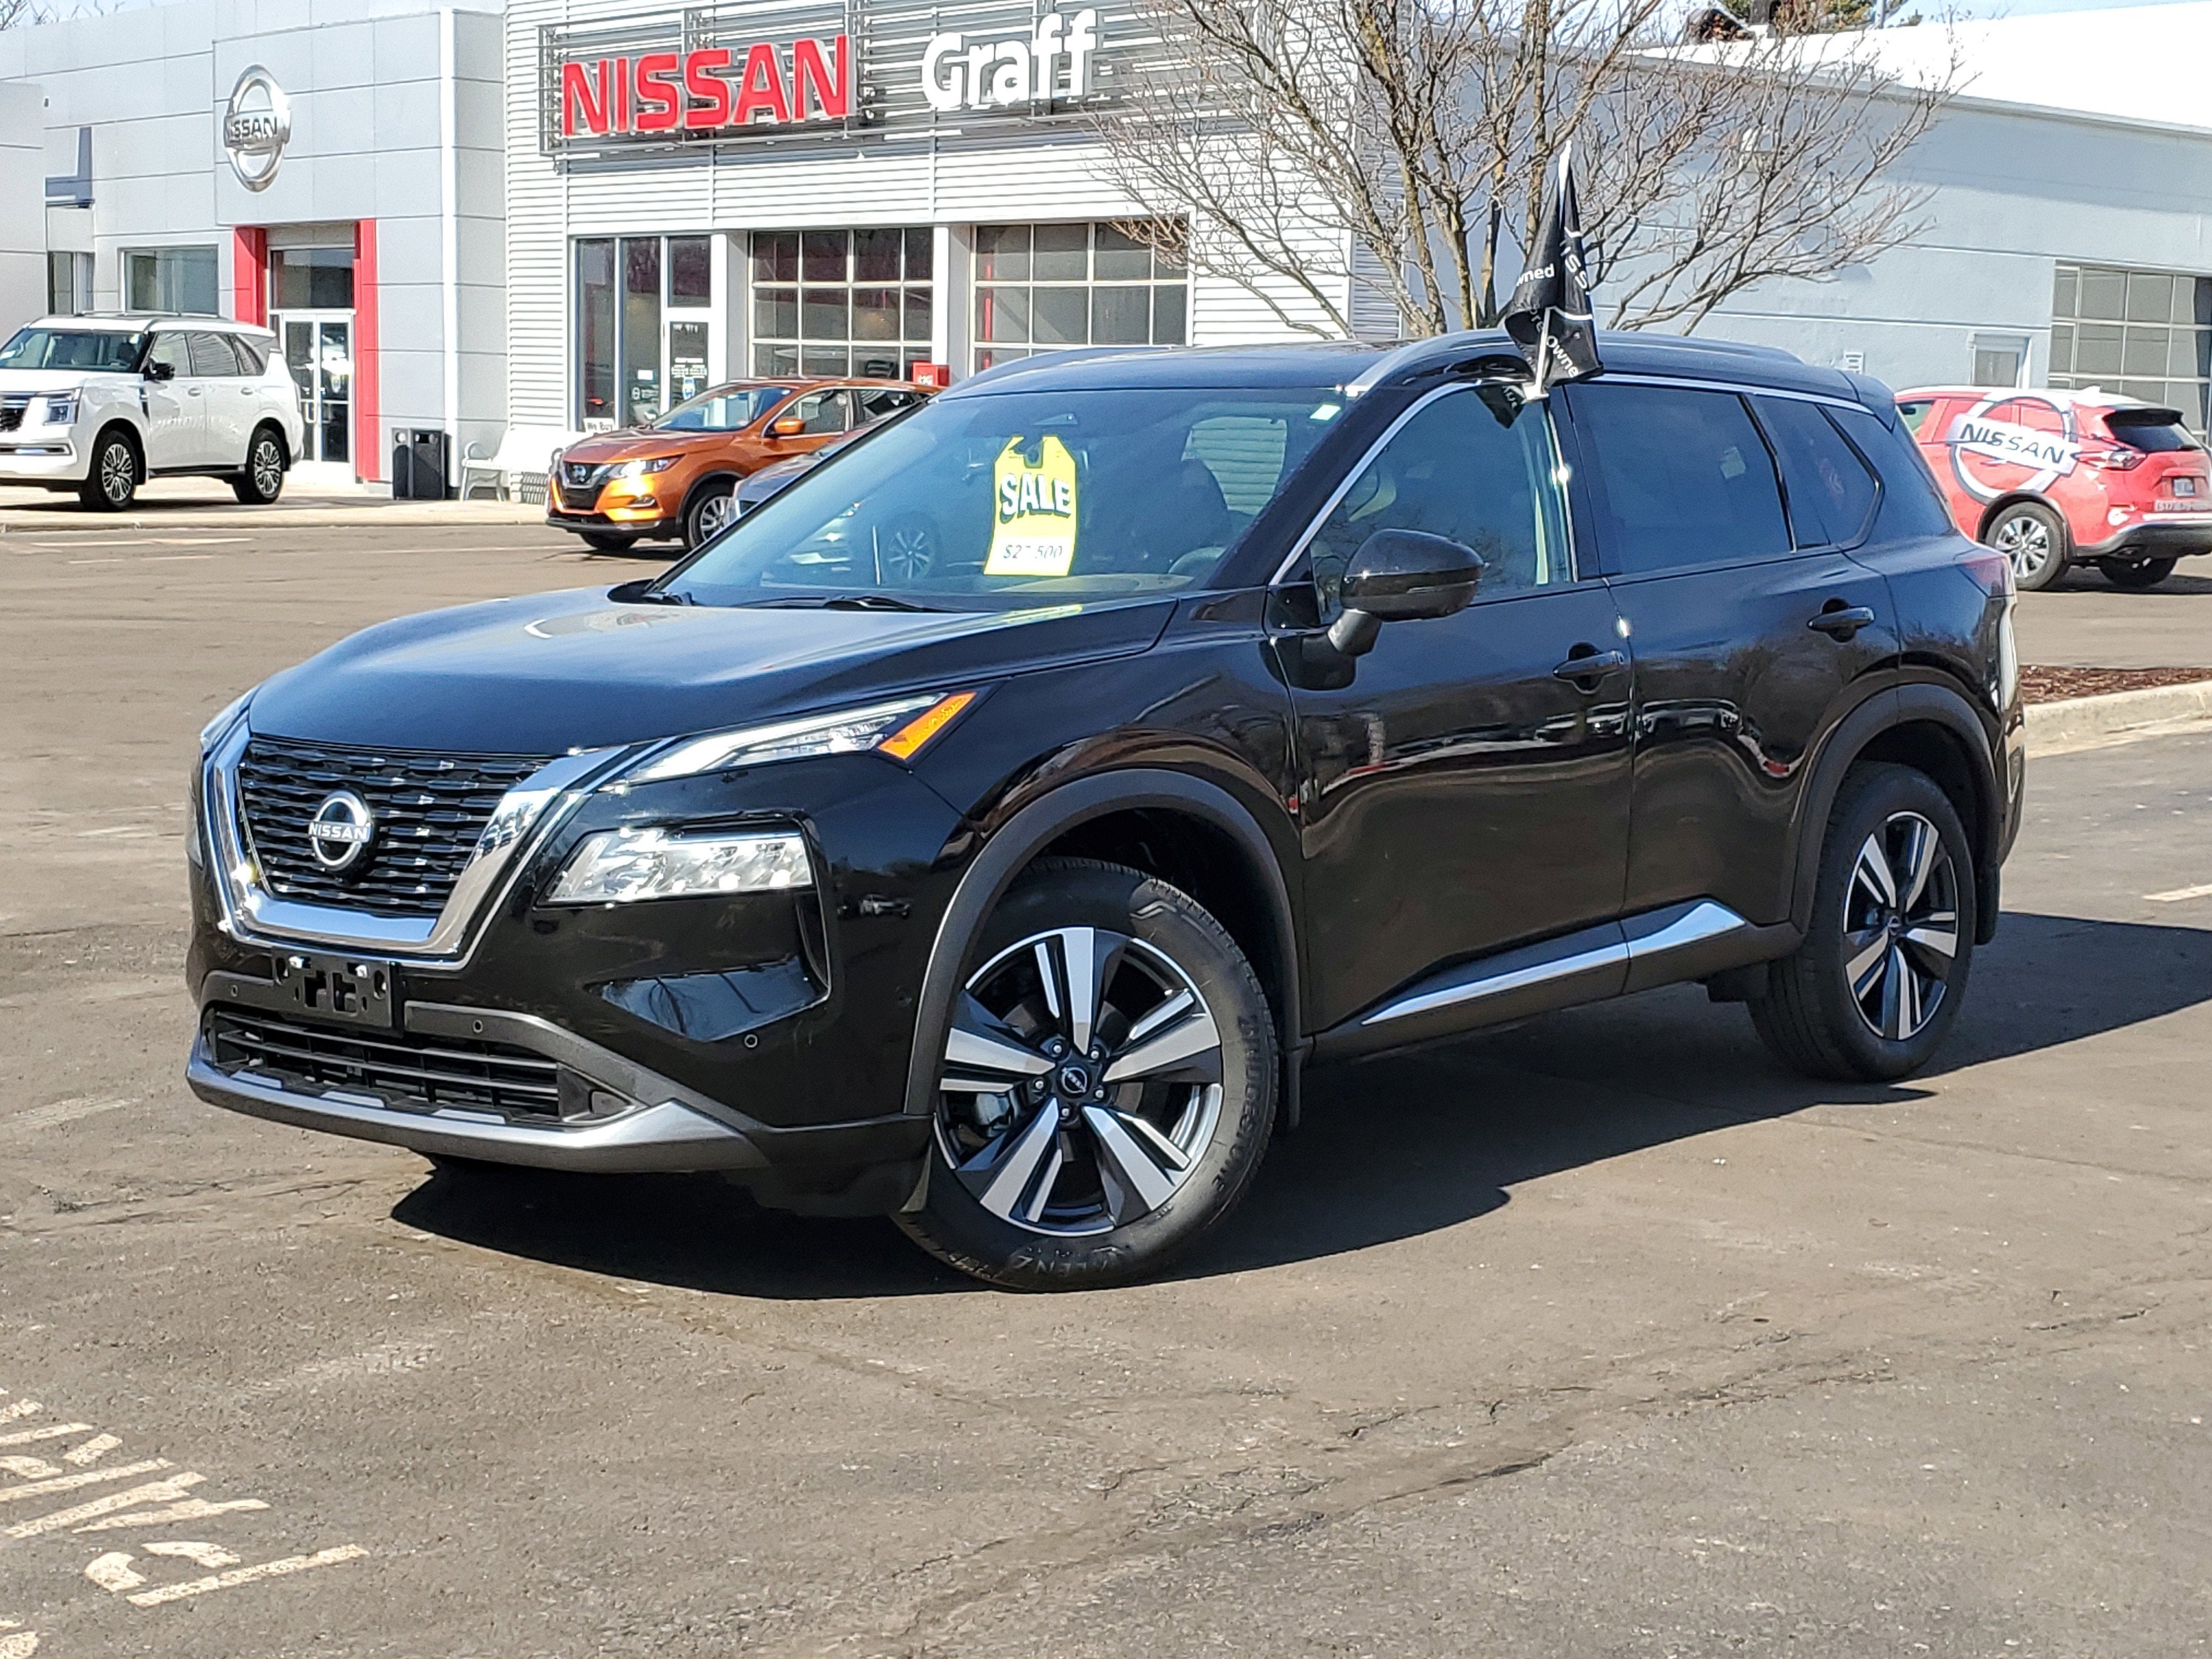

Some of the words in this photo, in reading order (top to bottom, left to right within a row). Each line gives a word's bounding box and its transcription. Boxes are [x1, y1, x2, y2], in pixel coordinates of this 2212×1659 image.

[561, 34, 852, 137] NISSAN
[922, 8, 1098, 111] Graff
[1959, 422, 2065, 464] NISSAN
[999, 472, 1072, 524] SALE
[309, 822, 367, 839] NISSAN
